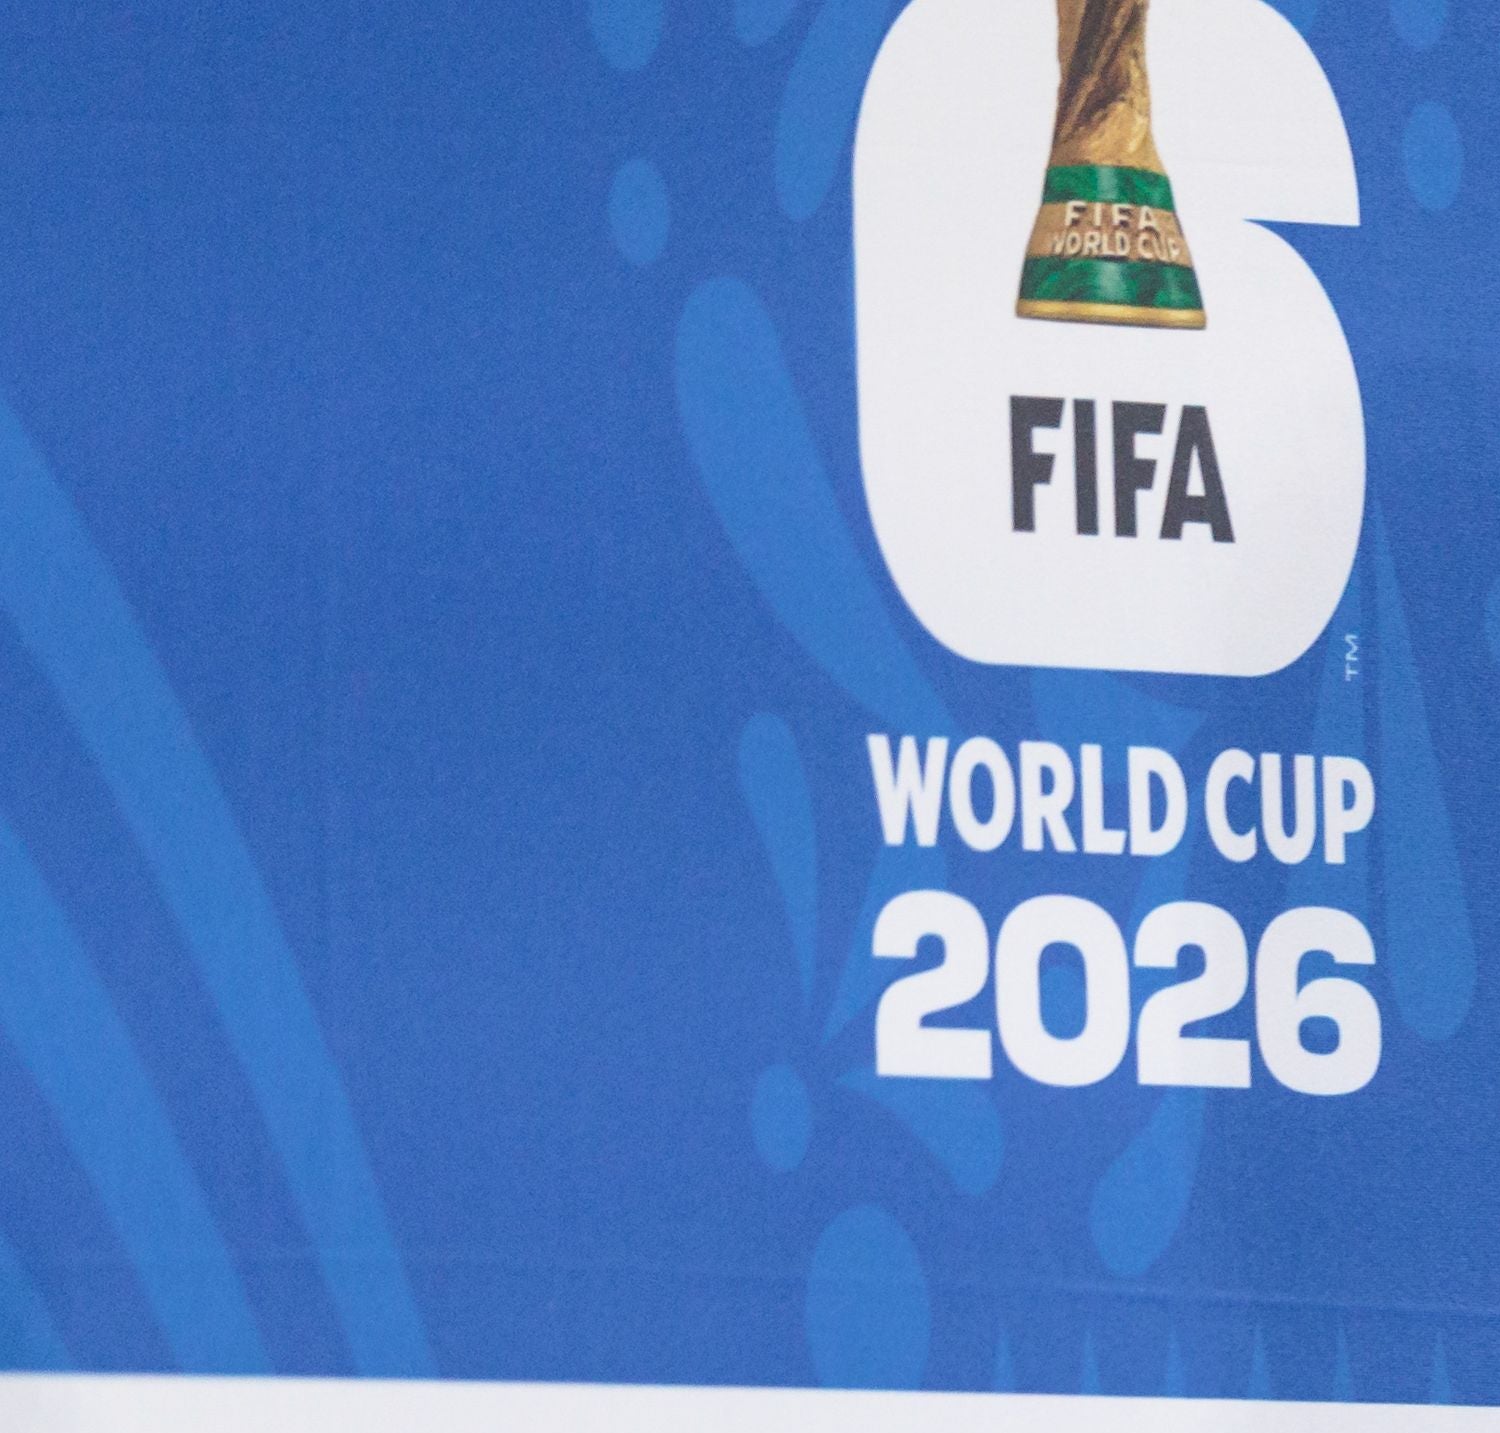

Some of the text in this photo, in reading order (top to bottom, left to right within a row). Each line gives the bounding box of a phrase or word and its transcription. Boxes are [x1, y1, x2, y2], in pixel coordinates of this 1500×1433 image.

[1065, 201, 1159, 230] FIFA
[1138, 234, 1181, 261] CUP
[1009, 395, 1235, 543] FIFA
[867, 734, 1375, 864] WORLD CUP
[872, 889, 1381, 1096] 2026
